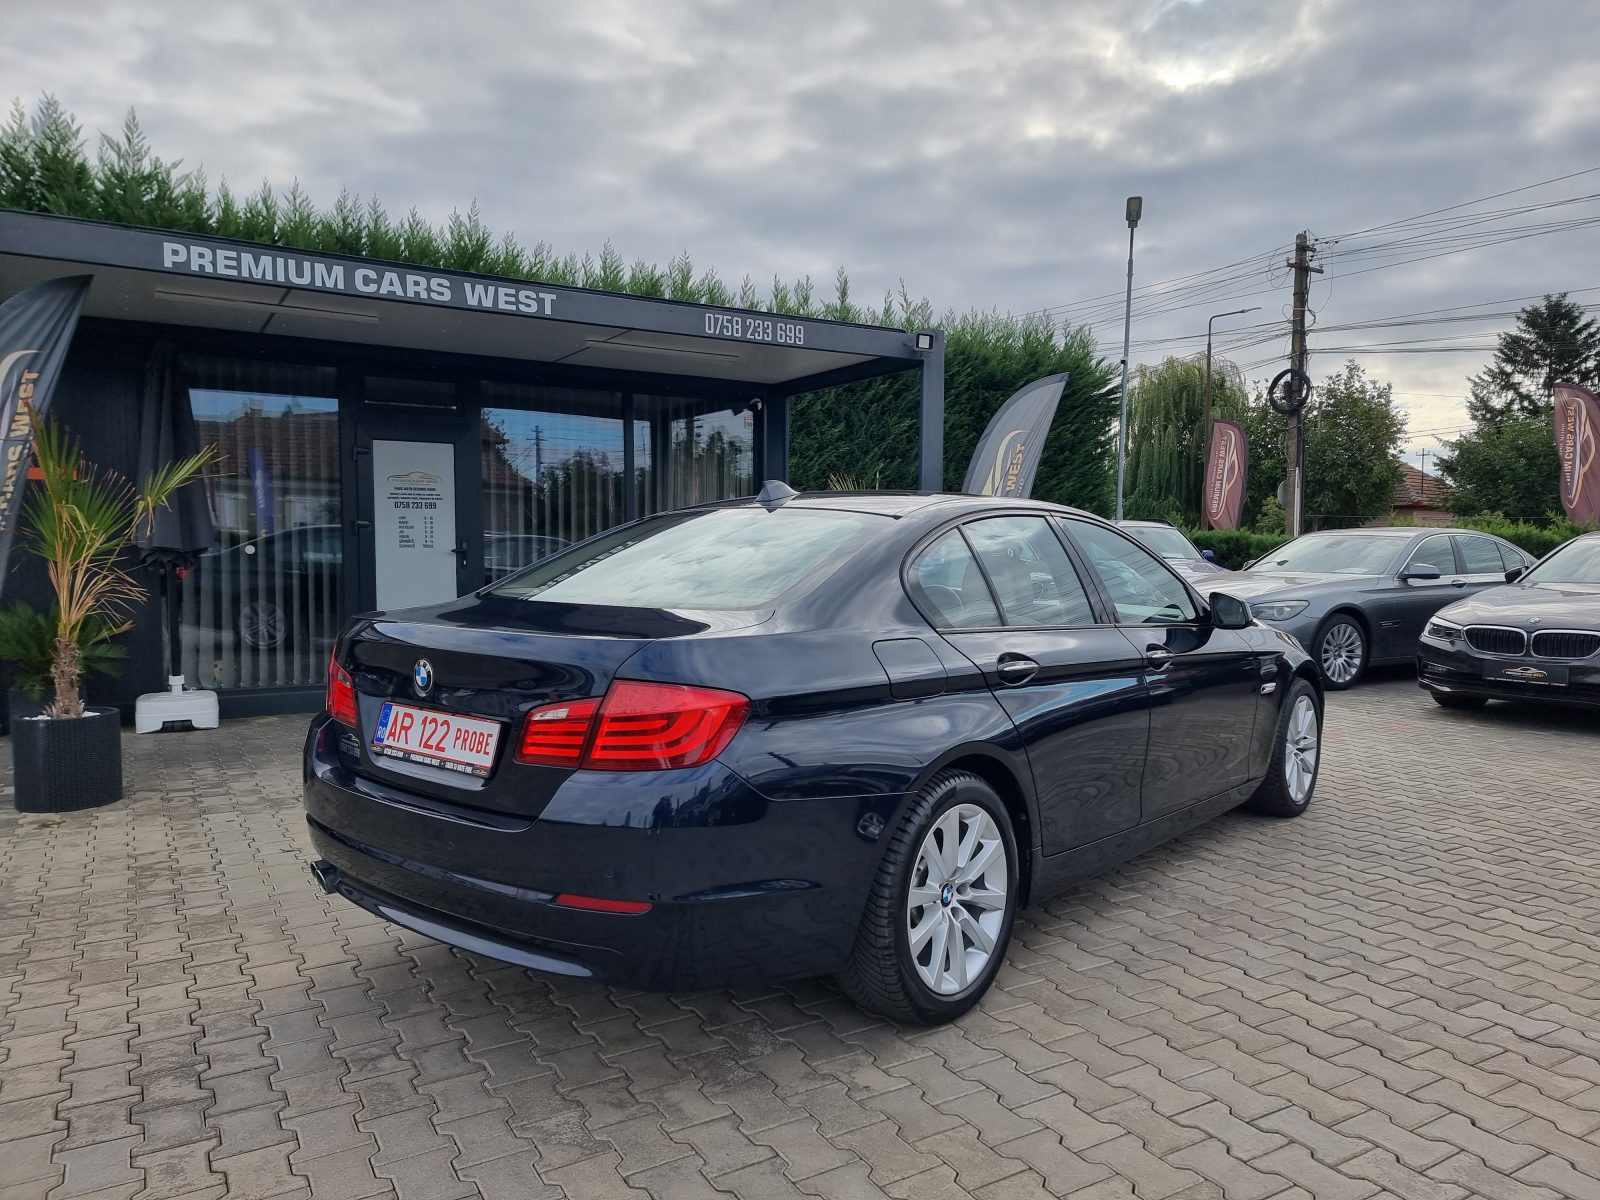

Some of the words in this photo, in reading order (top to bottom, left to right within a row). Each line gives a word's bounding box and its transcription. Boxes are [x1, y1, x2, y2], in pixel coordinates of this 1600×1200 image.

[162, 241, 345, 290] PREMIUM
[353, 267, 452, 302] CARS
[463, 282, 557, 315] WEST
[705, 313, 742, 337] 0758
[746, 318, 772, 342] 233
[777, 322, 804, 345] 699
[10, 368, 39, 438] WEST
[1006, 443, 1025, 491] WEST
[394, 501, 410, 509] 0758
[411, 501, 423, 509] 233
[424, 501, 437, 510] 699
[386, 710, 415, 745] AR
[418, 716, 451, 752] 122
[453, 727, 494, 756] PROBE
